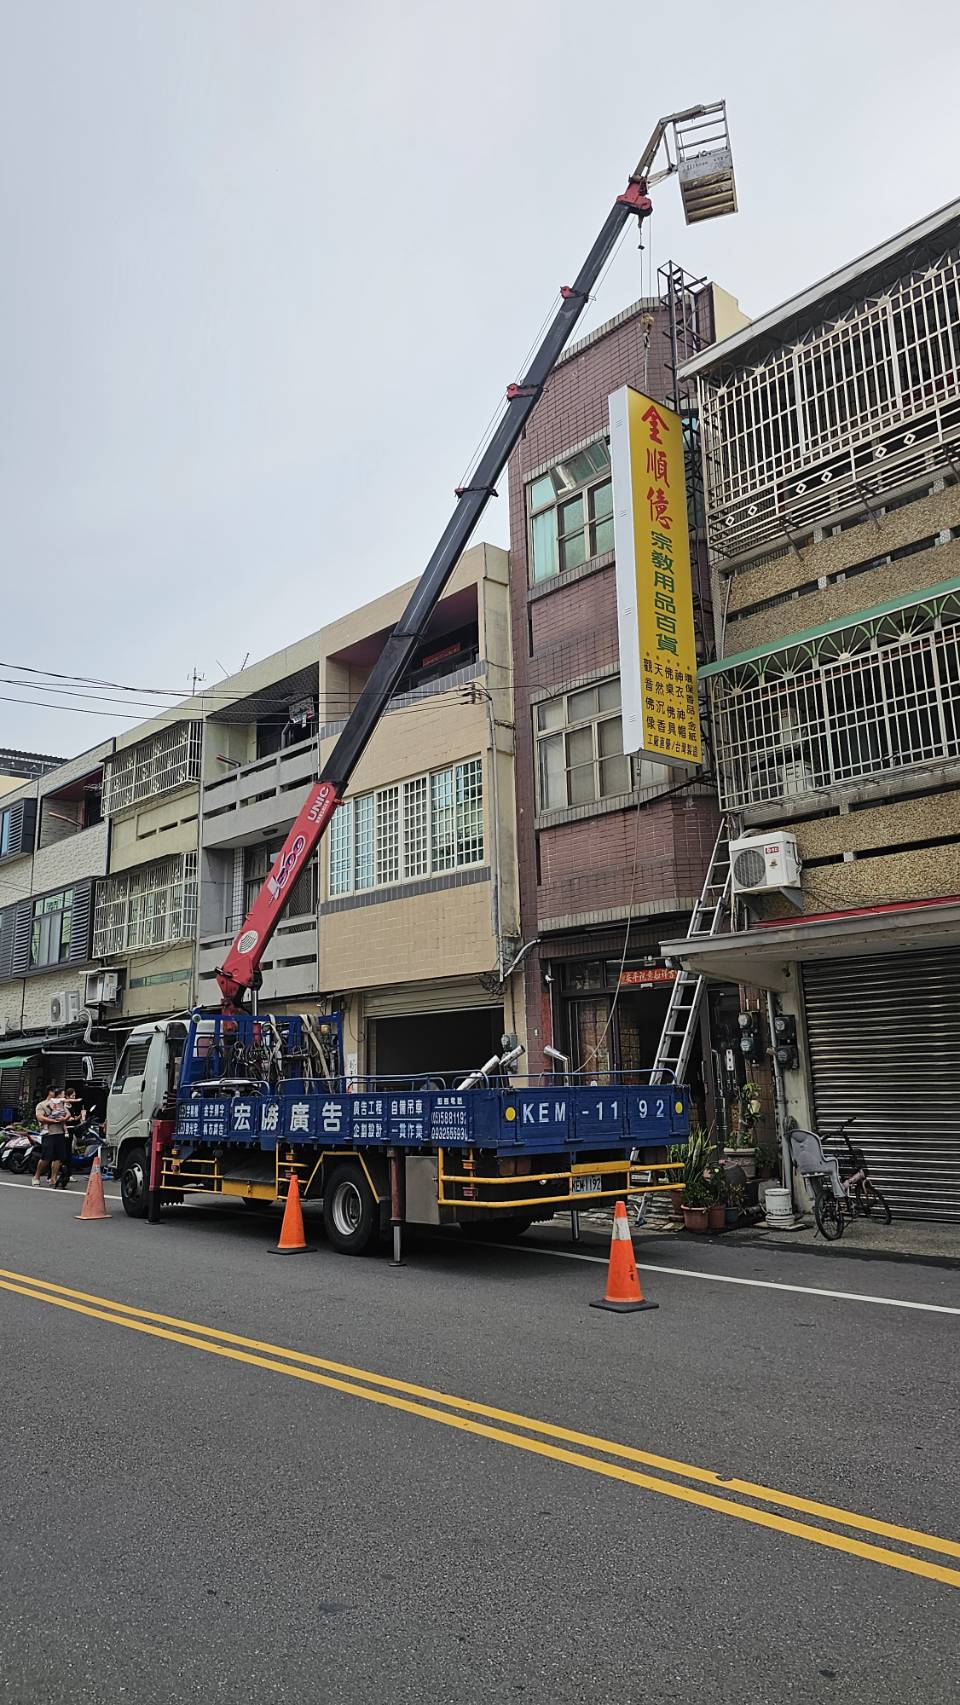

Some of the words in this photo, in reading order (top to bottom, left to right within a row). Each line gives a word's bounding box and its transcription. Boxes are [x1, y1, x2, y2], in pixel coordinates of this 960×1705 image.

[654, 662, 666, 734] 天然沉香
[307, 786, 330, 822] UNIC
[353, 1100, 383, 1115] 廣告工程
[391, 1099, 423, 1115] 自備吊車
[234, 1101, 343, 1132] 宏勝廣告
[353, 1123, 383, 1138] 企劃設計
[391, 1122, 423, 1139] 一貫作業
